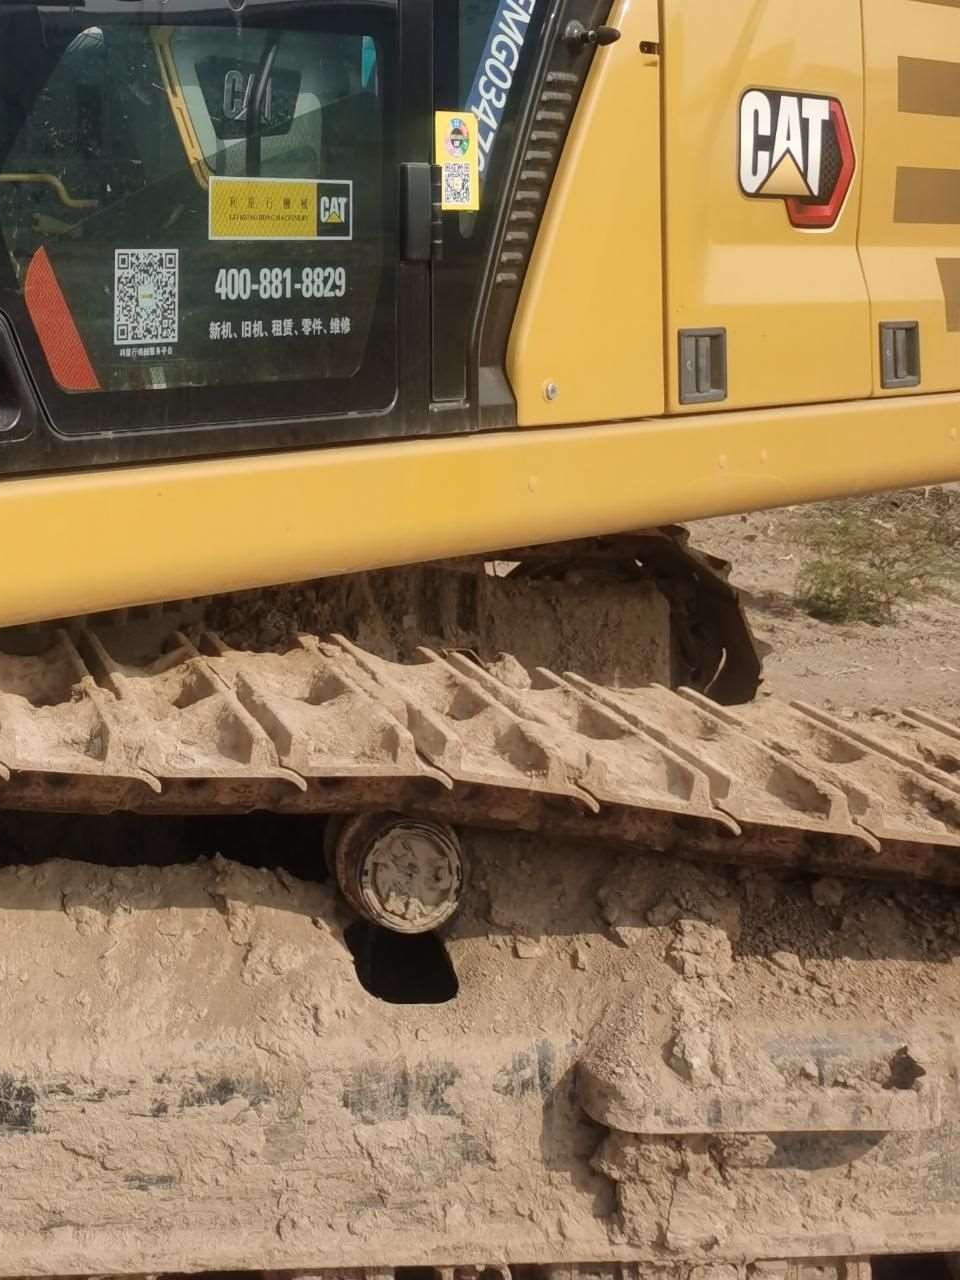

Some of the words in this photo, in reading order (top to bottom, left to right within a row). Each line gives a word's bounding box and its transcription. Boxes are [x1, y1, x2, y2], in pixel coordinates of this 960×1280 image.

[740, 90, 830, 197] CAT
[320, 196, 348, 223] CAT
[215, 267, 346, 300] 400-881-8829
[209, 316, 352, 340] 新机、旧机、租赁、零件、维修
